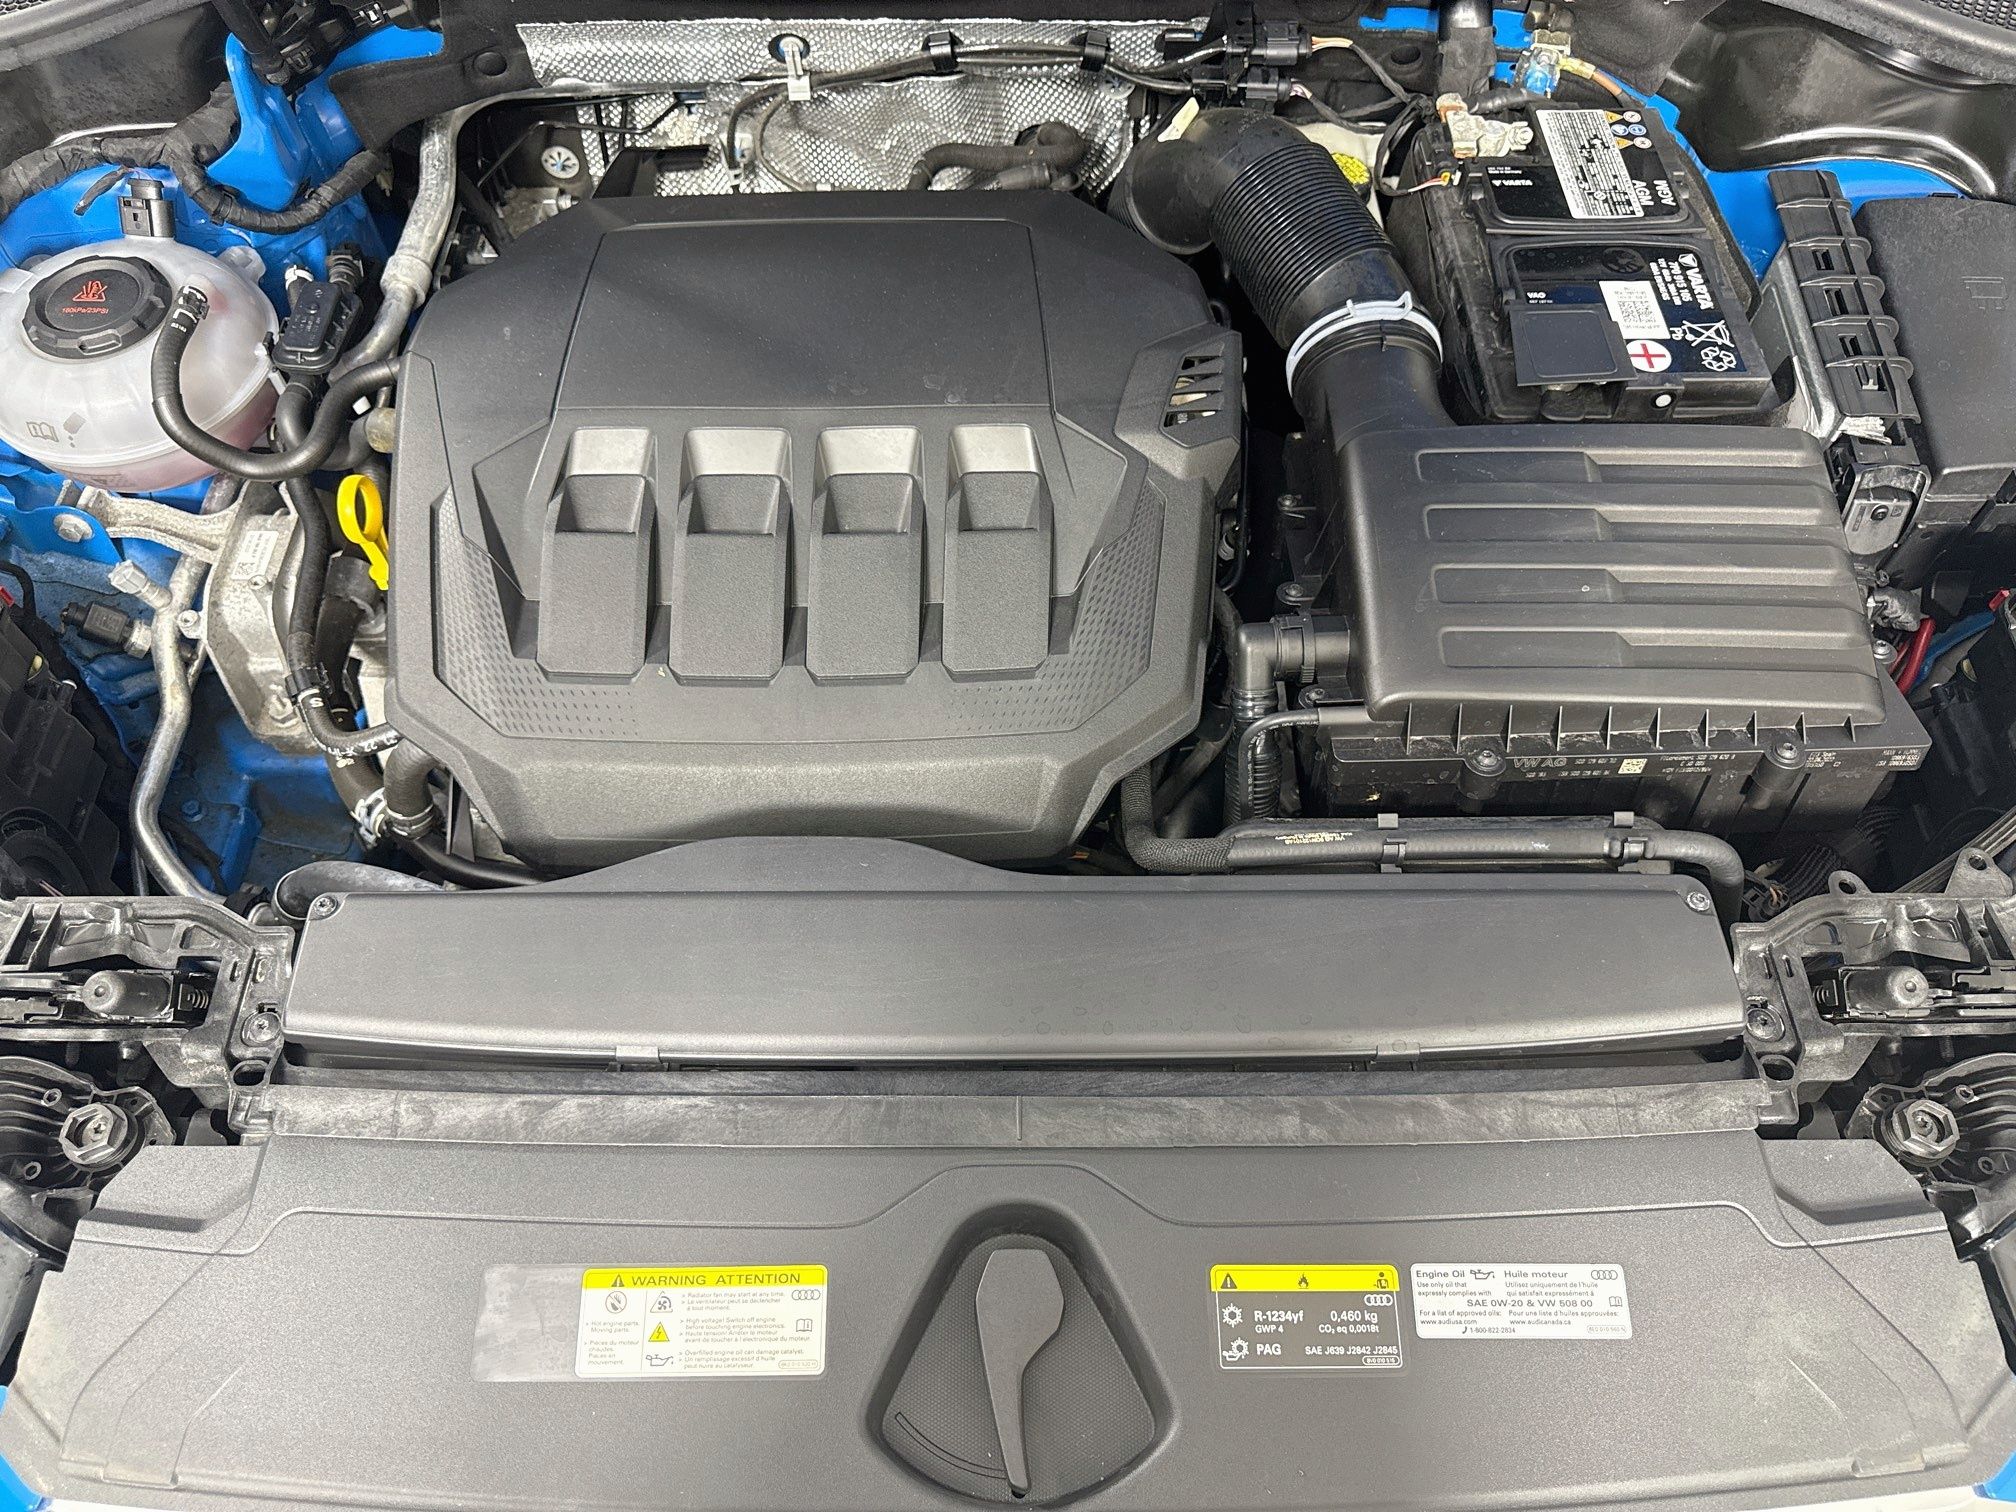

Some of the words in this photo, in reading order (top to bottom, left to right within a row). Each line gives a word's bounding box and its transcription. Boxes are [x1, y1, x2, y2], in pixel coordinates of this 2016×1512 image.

[1632, 180, 1654, 205] AGM
[1653, 180, 1676, 206] AGM
[1686, 267, 1714, 310] VARTA
[1670, 327, 1684, 340] Pb
[1513, 757, 1541, 768] VW
[1540, 757, 1567, 768] AG
[631, 1275, 706, 1286] WARNING
[716, 1273, 801, 1284] ATTENTION
[1416, 1270, 1449, 1279] Engine
[1452, 1270, 1465, 1278] Oil
[1504, 1270, 1529, 1278] Huile
[1530, 1281, 1568, 1289] uniquement
[1467, 1299, 1488, 1307] SAE
[1490, 1299, 1524, 1307] 0W-20
[1526, 1299, 1535, 1307] &
[1537, 1299, 1556, 1307] VW
[1560, 1299, 1578, 1307] 508
[1580, 1299, 1593, 1307] 00
[1254, 1310, 1304, 1324] R-1234yf
[1330, 1310, 1361, 1323] 0,460
[1364, 1310, 1378, 1324] kg
[1255, 1324, 1277, 1334] GWP
[1278, 1325, 1284, 1333] 4
[1336, 1325, 1348, 1335] eq
[1349, 1324, 1380, 1334] 0,0018t
[1256, 1343, 1282, 1355] PAG
[1305, 1346, 1323, 1355] SAE
[1324, 1346, 1345, 1355] J639
[1346, 1346, 1371, 1355] J2842
[1372, 1345, 1398, 1355] J2845
